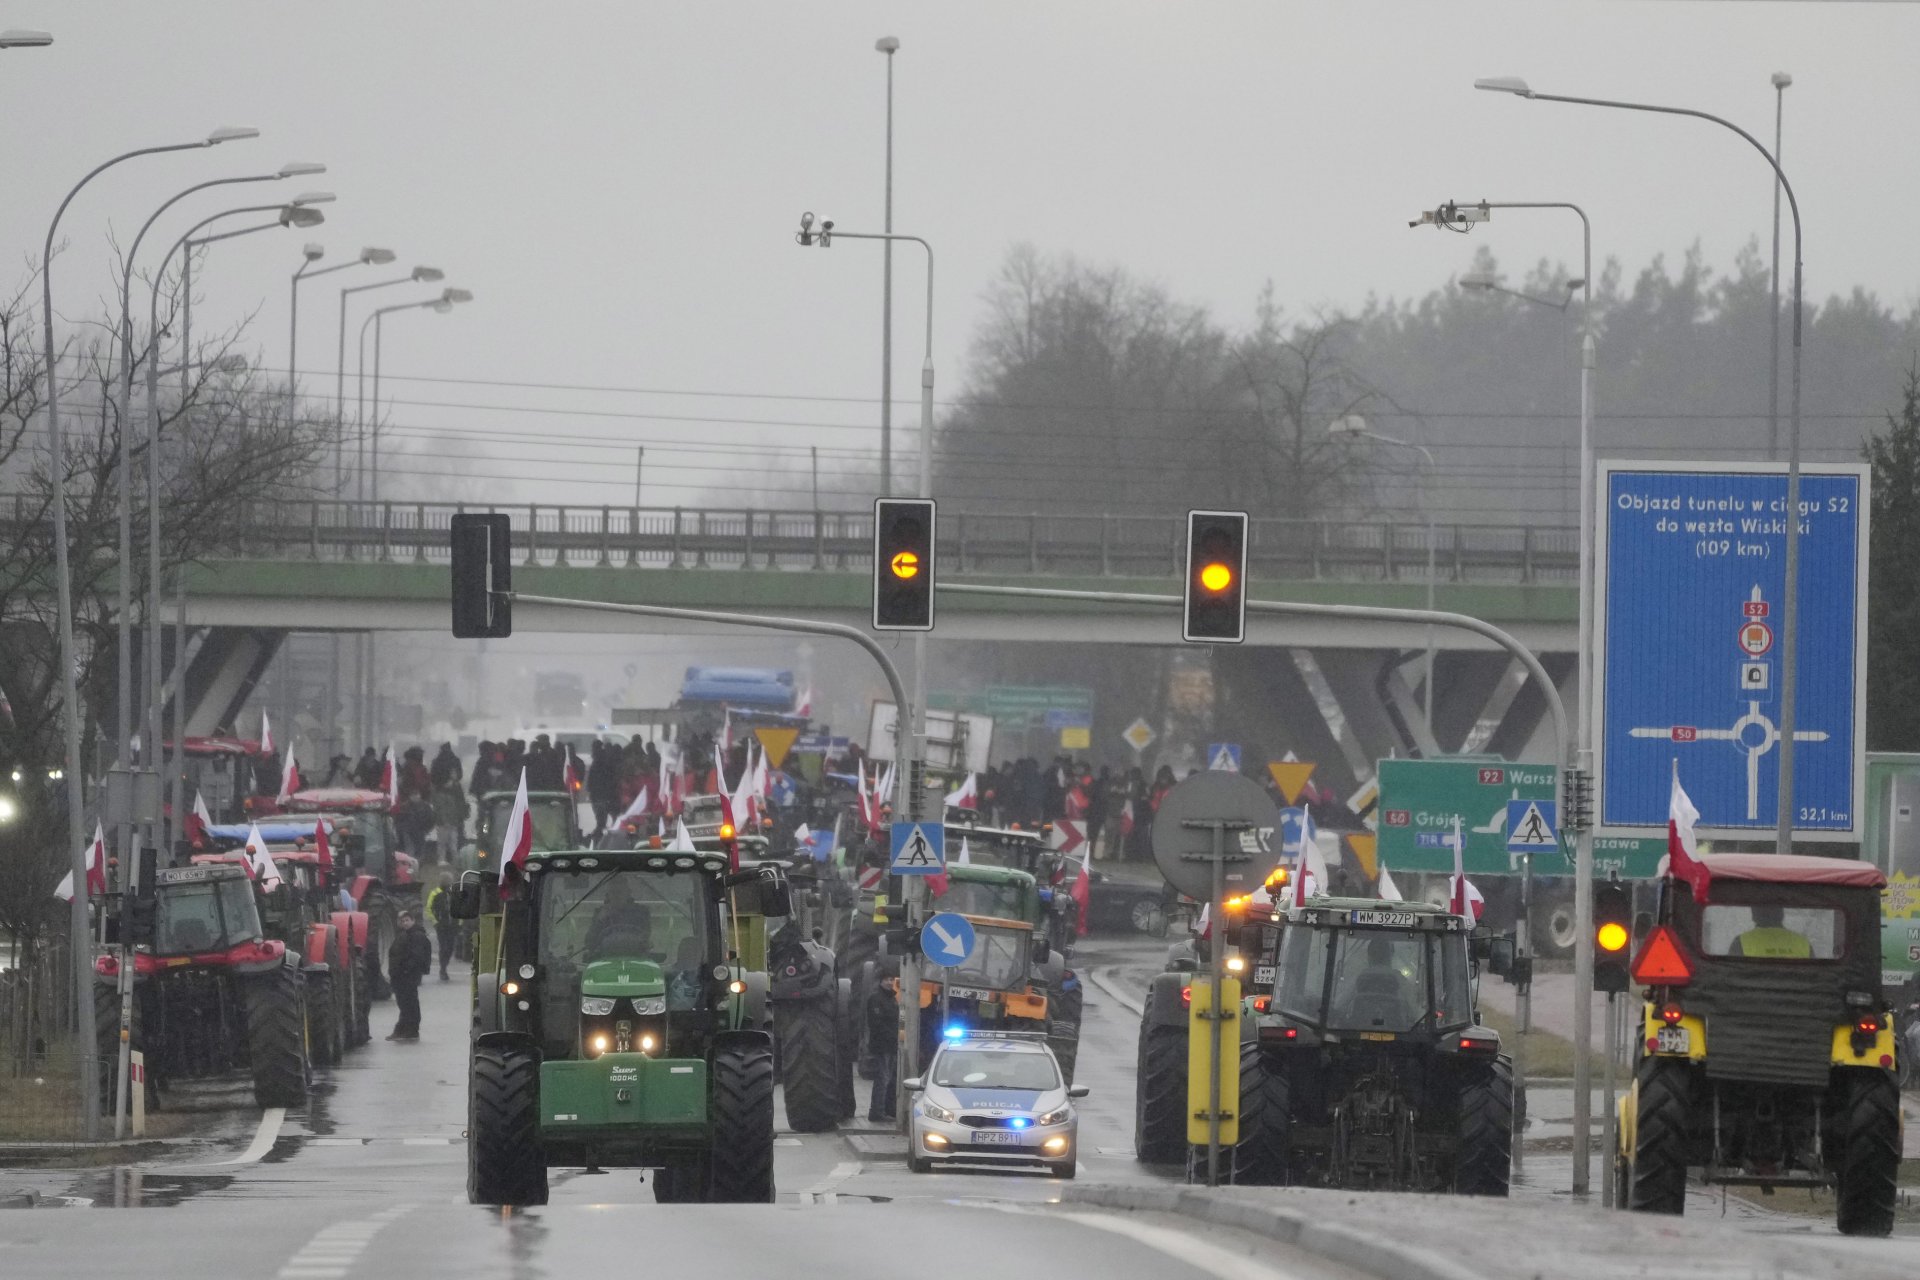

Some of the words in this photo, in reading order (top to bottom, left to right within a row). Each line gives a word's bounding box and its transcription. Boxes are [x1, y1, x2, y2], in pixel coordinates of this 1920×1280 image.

[1617, 494, 1680, 513] Objazd
[1688, 496, 1744, 511] tunelu
[1752, 501, 1764, 511] w
[1770, 497, 1820, 516] cigu
[1828, 498, 1849, 513] S2
[1656, 517, 1678, 532] do
[1685, 518, 1734, 537] węzła
[1741, 518, 1810, 535] Wiskiki
[1696, 540, 1729, 558] (109
[1737, 541, 1770, 559] km)
[1749, 604, 1764, 615] S2
[1677, 728, 1692, 739] 50
[1484, 770, 1499, 783] 92
[1509, 770, 1557, 785] Warsz
[1800, 807, 1826, 822] 32,1
[1831, 810, 1848, 821] km
[1564, 834, 1640, 850] Wszawa
[1359, 911, 1374, 923] WM
[1378, 912, 1412, 924] 3927P
[972, 1100, 1022, 1109] POLICJA
[977, 1133, 996, 1142] HPZ
